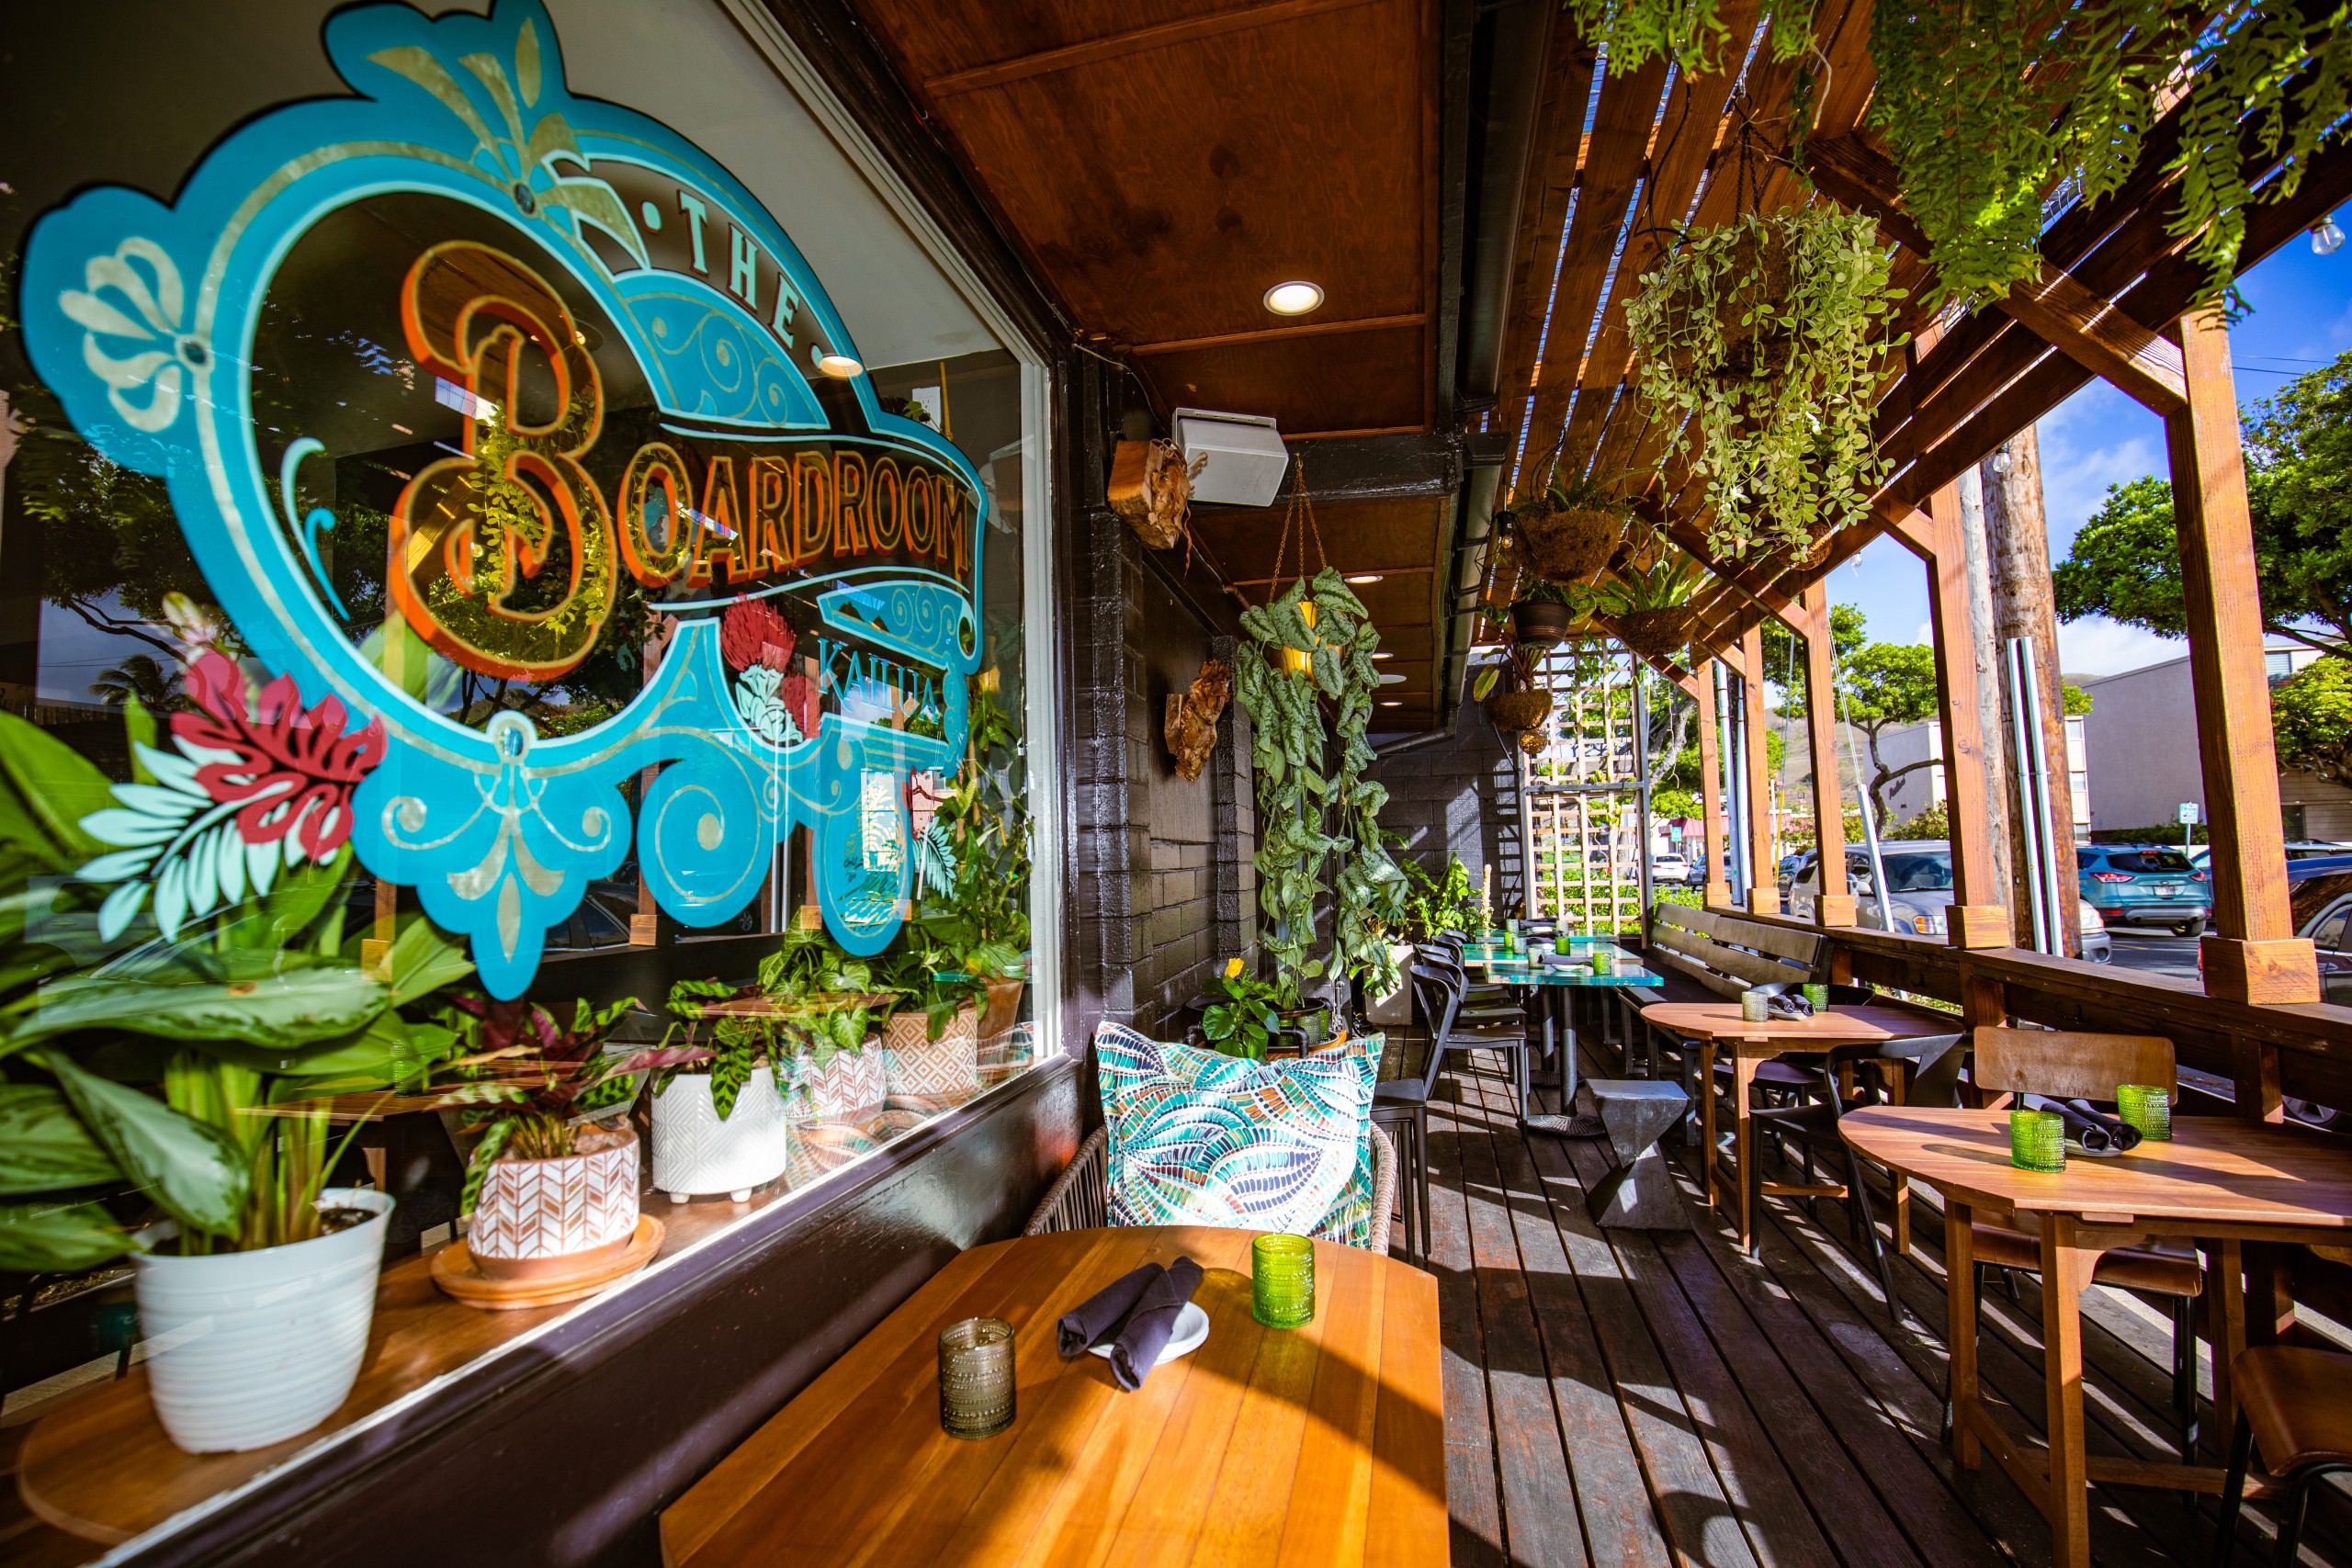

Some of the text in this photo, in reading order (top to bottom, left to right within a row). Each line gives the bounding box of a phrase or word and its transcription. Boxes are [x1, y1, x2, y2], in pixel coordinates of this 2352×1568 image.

[676, 188, 800, 344] THE
[391, 239, 970, 681] BOARDROOM
[817, 637, 940, 726] KAILUA
